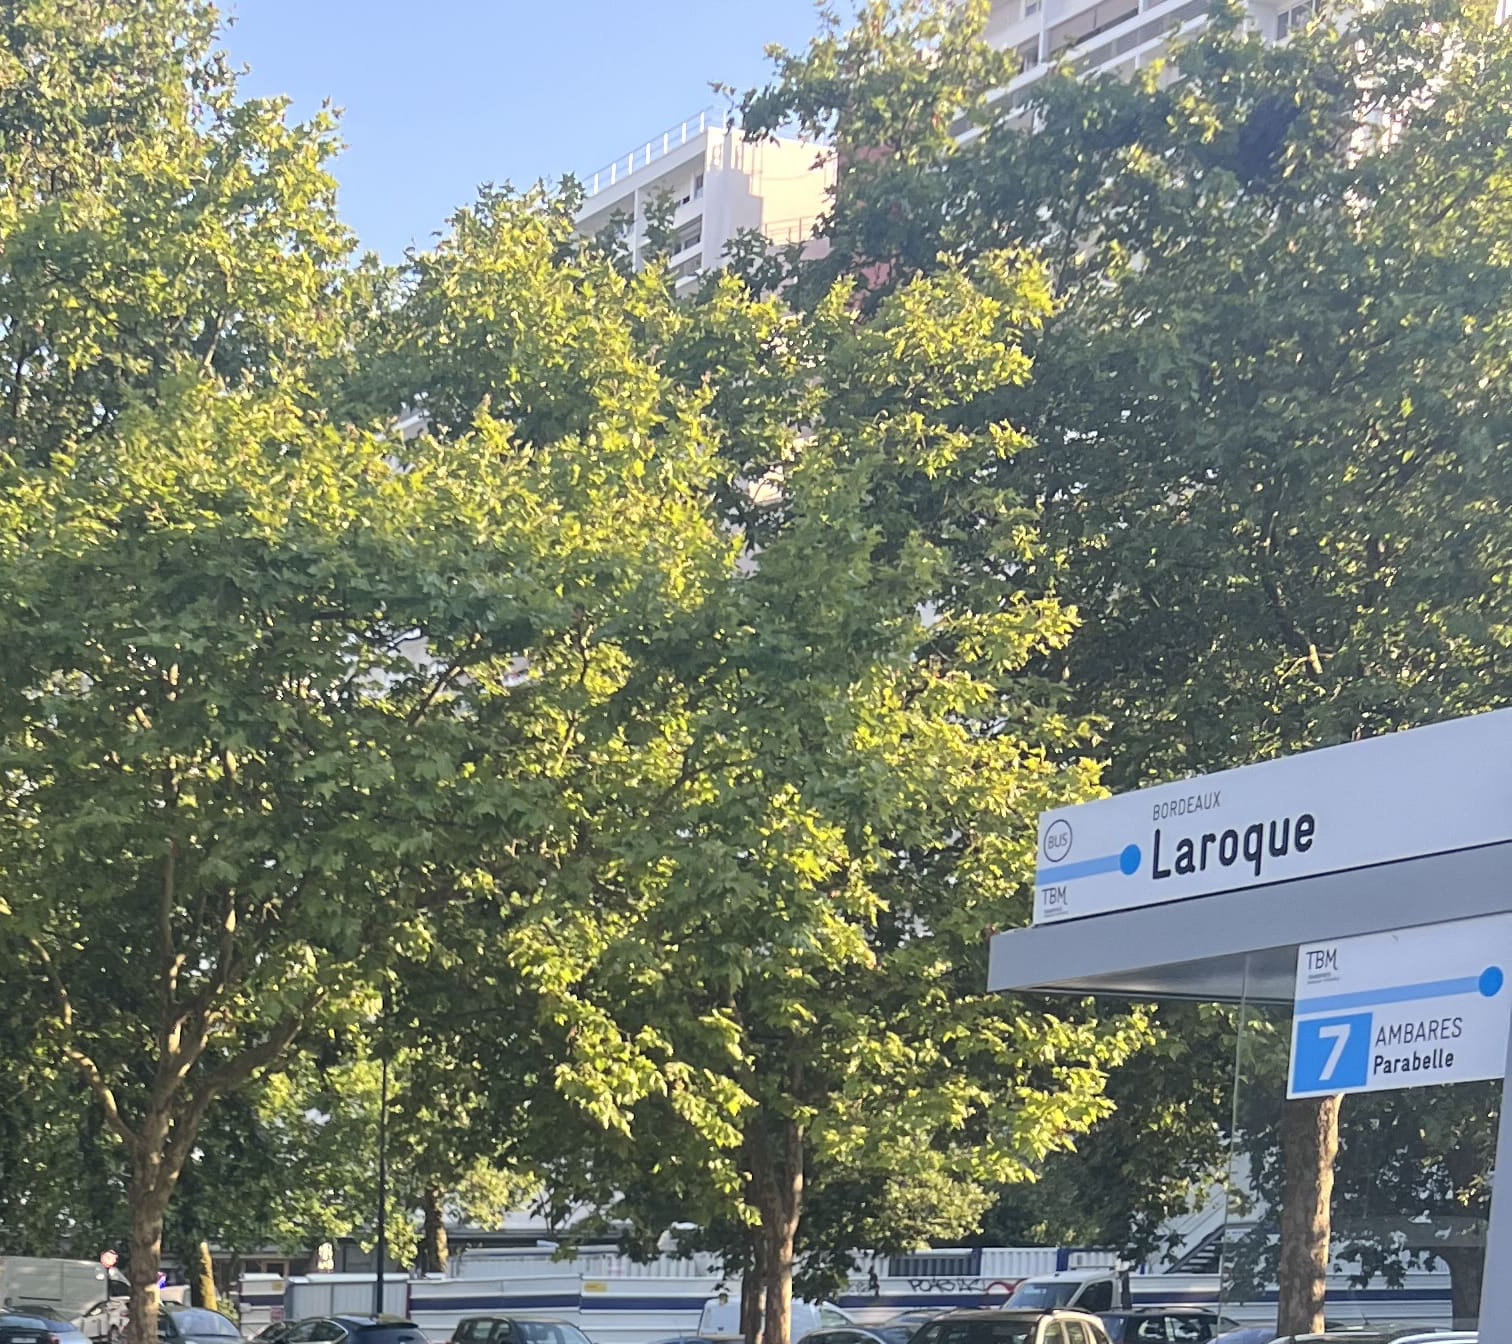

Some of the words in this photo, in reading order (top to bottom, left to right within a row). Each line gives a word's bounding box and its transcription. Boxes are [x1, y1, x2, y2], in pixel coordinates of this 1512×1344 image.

[1152, 790, 1221, 821] BORDEAUX
[1047, 832, 1068, 850] BUS
[1152, 813, 1315, 879] Laroque
[1041, 885, 1068, 906] TBM
[1305, 948, 1338, 971] TBM
[1318, 1023, 1351, 1081] 7
[1375, 1016, 1463, 1048] AMBARES
[1373, 1048, 1454, 1075] Parabelle
